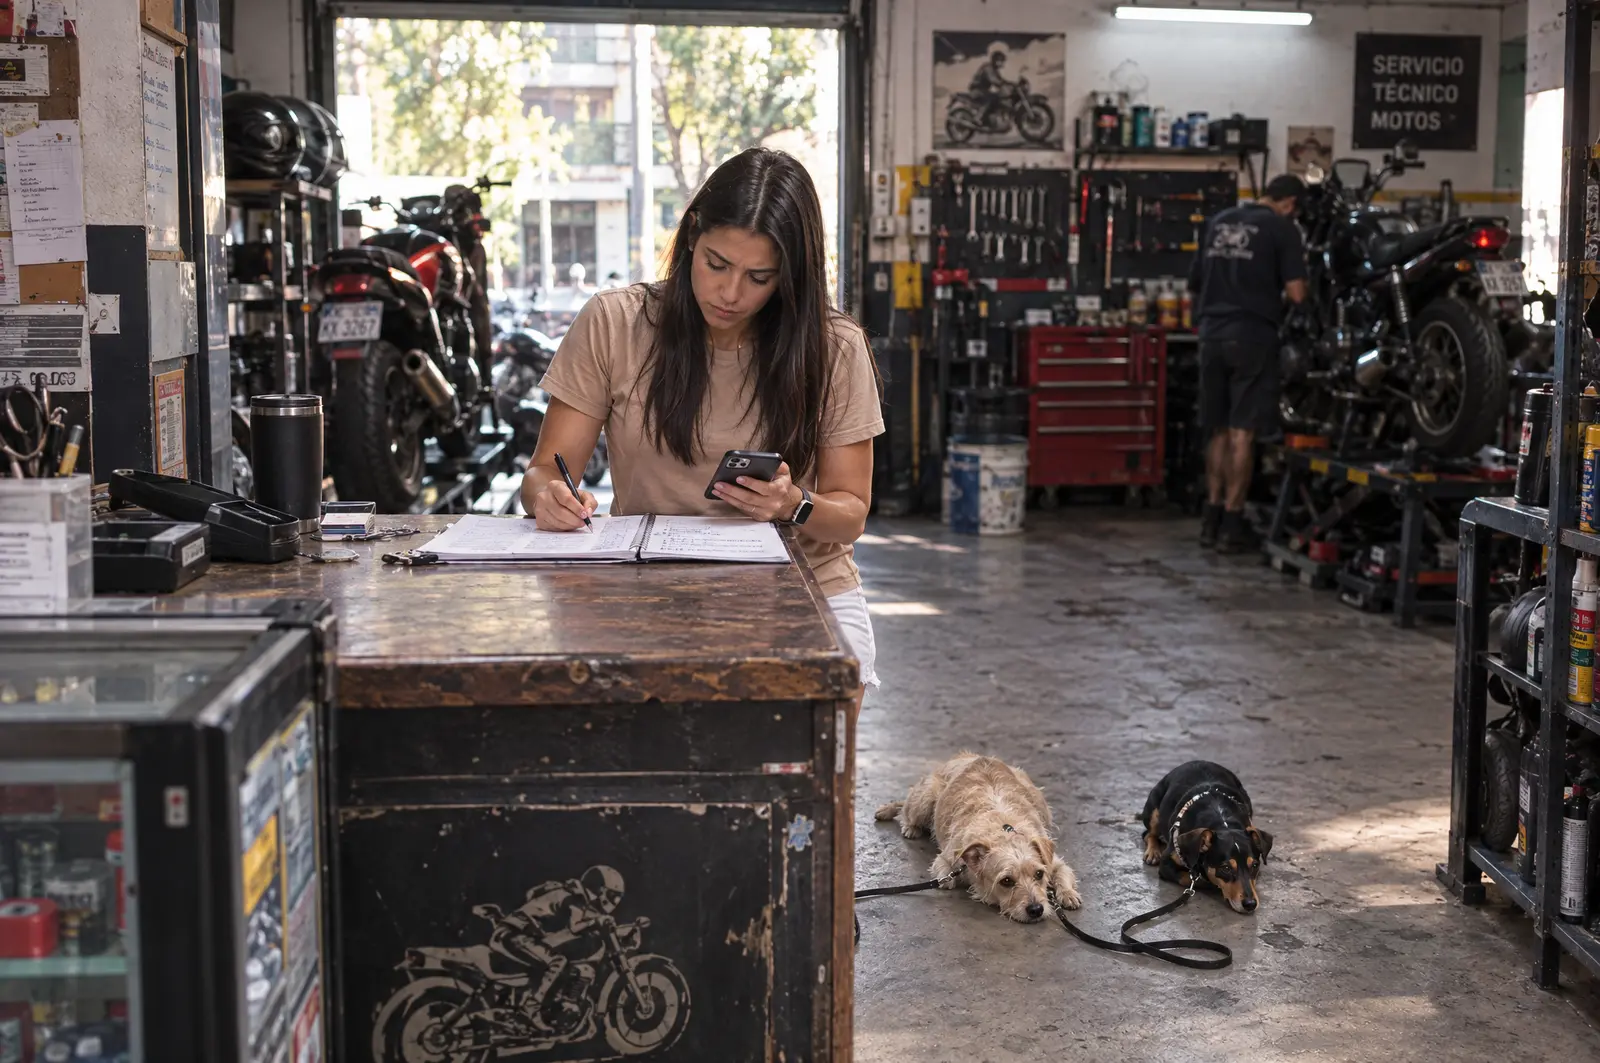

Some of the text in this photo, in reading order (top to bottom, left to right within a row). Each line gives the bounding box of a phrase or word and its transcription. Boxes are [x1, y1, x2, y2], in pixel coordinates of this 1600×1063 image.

[1373, 54, 1464, 76] SERVICIO
[1372, 78, 1459, 104] TÉCNICO
[1371, 111, 1441, 131] MOTOS
